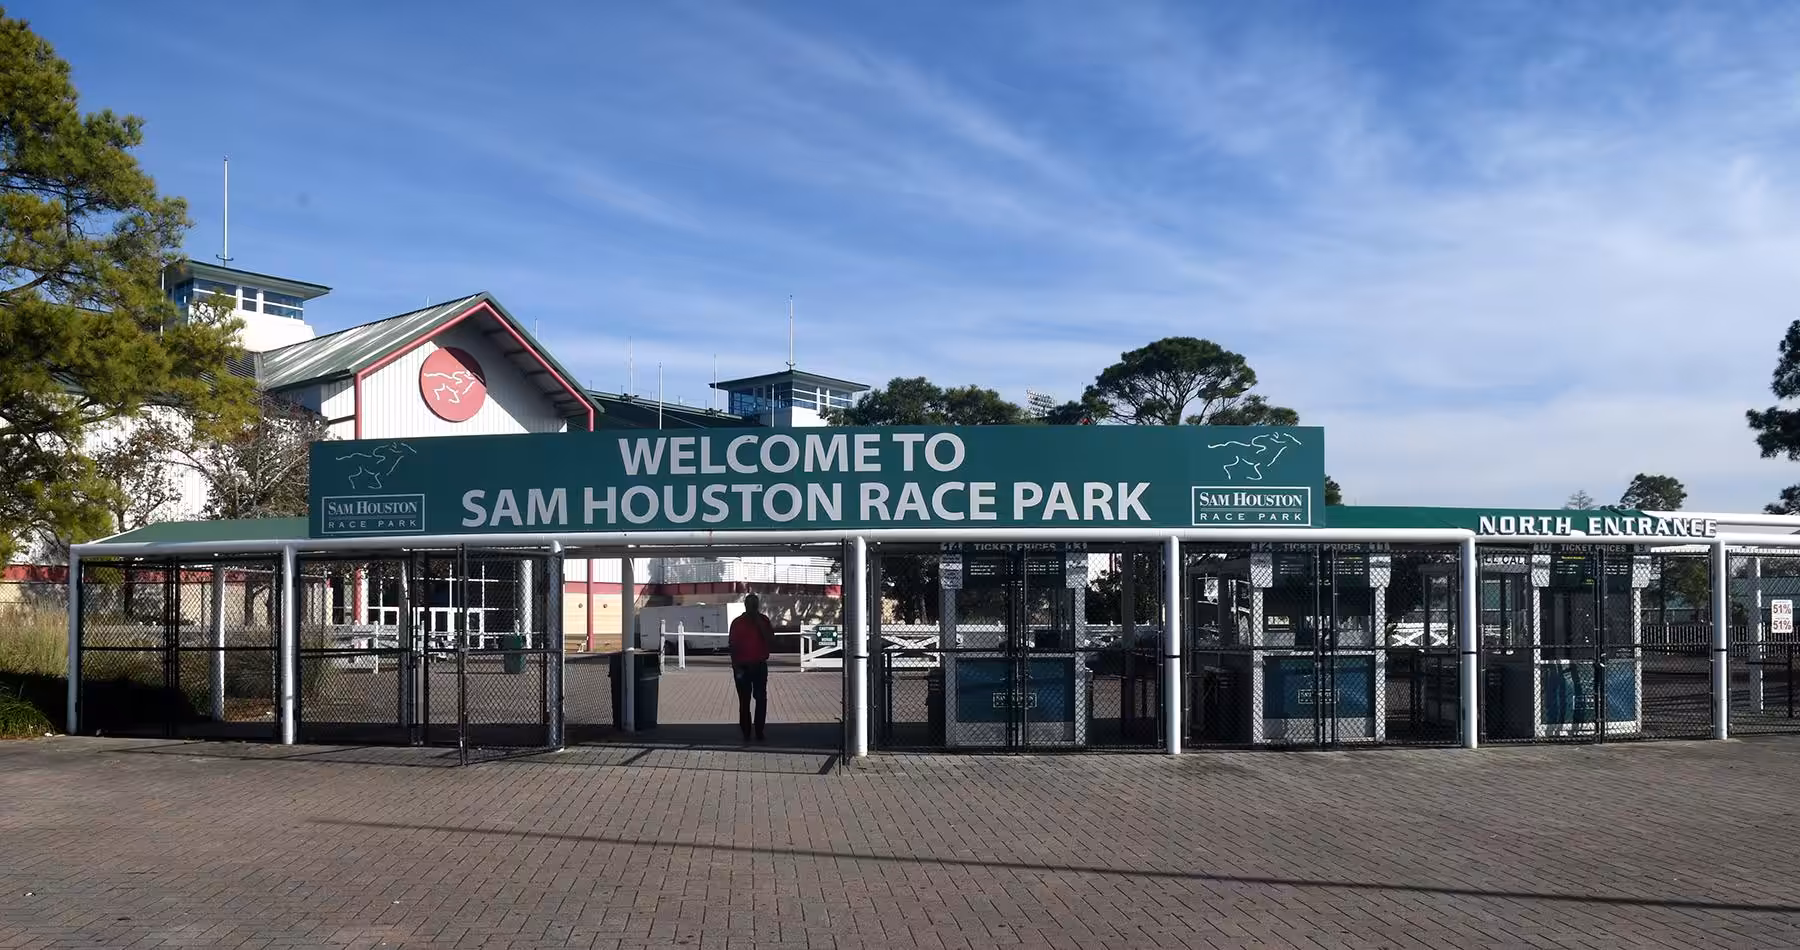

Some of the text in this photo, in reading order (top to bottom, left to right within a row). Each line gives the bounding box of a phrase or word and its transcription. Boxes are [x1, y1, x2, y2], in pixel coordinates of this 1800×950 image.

[618, 432, 966, 476] WELCOME TO
[1199, 491, 1303, 507] SAM HOUSTON
[327, 500, 418, 516] SAM HOUSTON
[461, 481, 1152, 528] SAM HOUSTON RACE PARK
[1200, 513, 1302, 521] RACE PARK
[327, 519, 417, 529] RACE PARK
[1478, 515, 1718, 539] NORTH ENTRANCE
[974, 543, 1057, 552] TICKET PRICES
[1283, 543, 1321, 552] TICKET
[1560, 543, 1627, 552] TICKET PRICES
[1773, 604, 1791, 614] 51%
[1773, 620, 1791, 630] 51%
